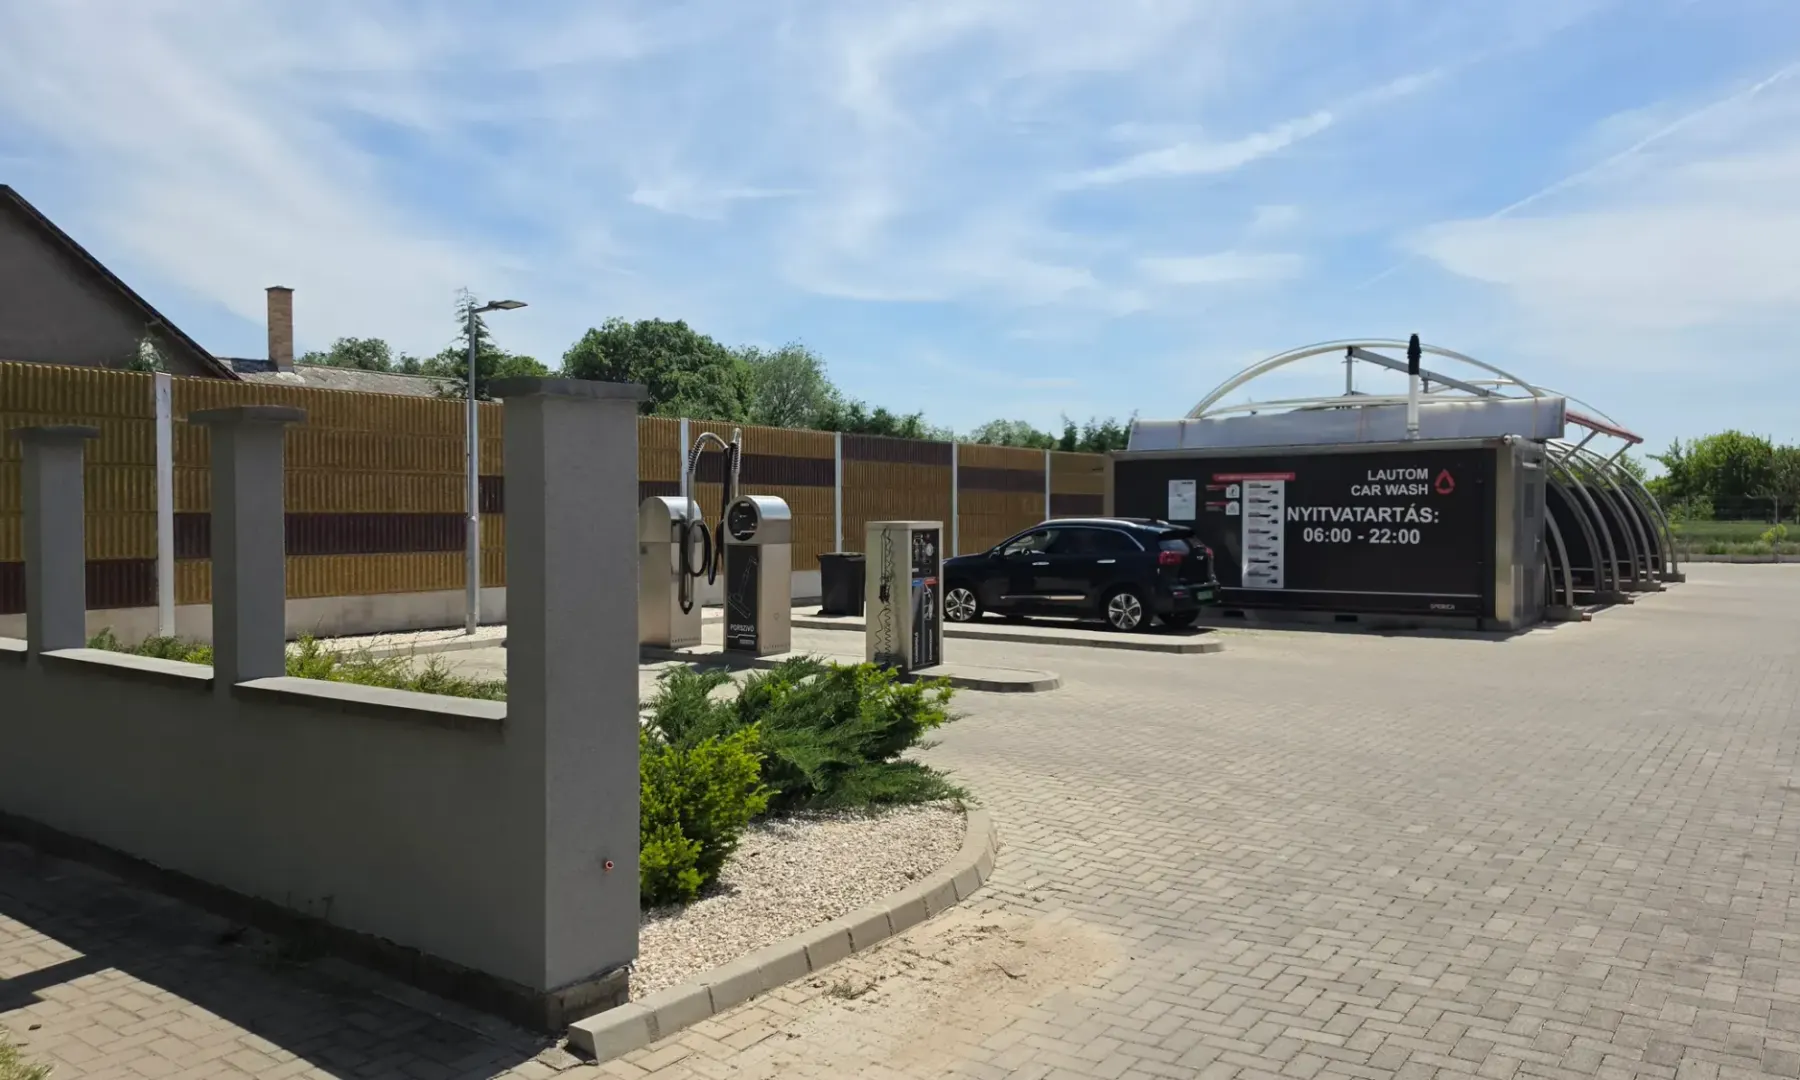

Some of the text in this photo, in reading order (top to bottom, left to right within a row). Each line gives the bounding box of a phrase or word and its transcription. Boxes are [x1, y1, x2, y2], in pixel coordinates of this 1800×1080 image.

[1367, 468, 1428, 481] LAUTOM
[1351, 483, 1428, 496] CAR WASH
[1287, 503, 1439, 523] NYITVATARTÁS:
[1303, 527, 1351, 543] 06:00
[1369, 528, 1420, 544] 22:00
